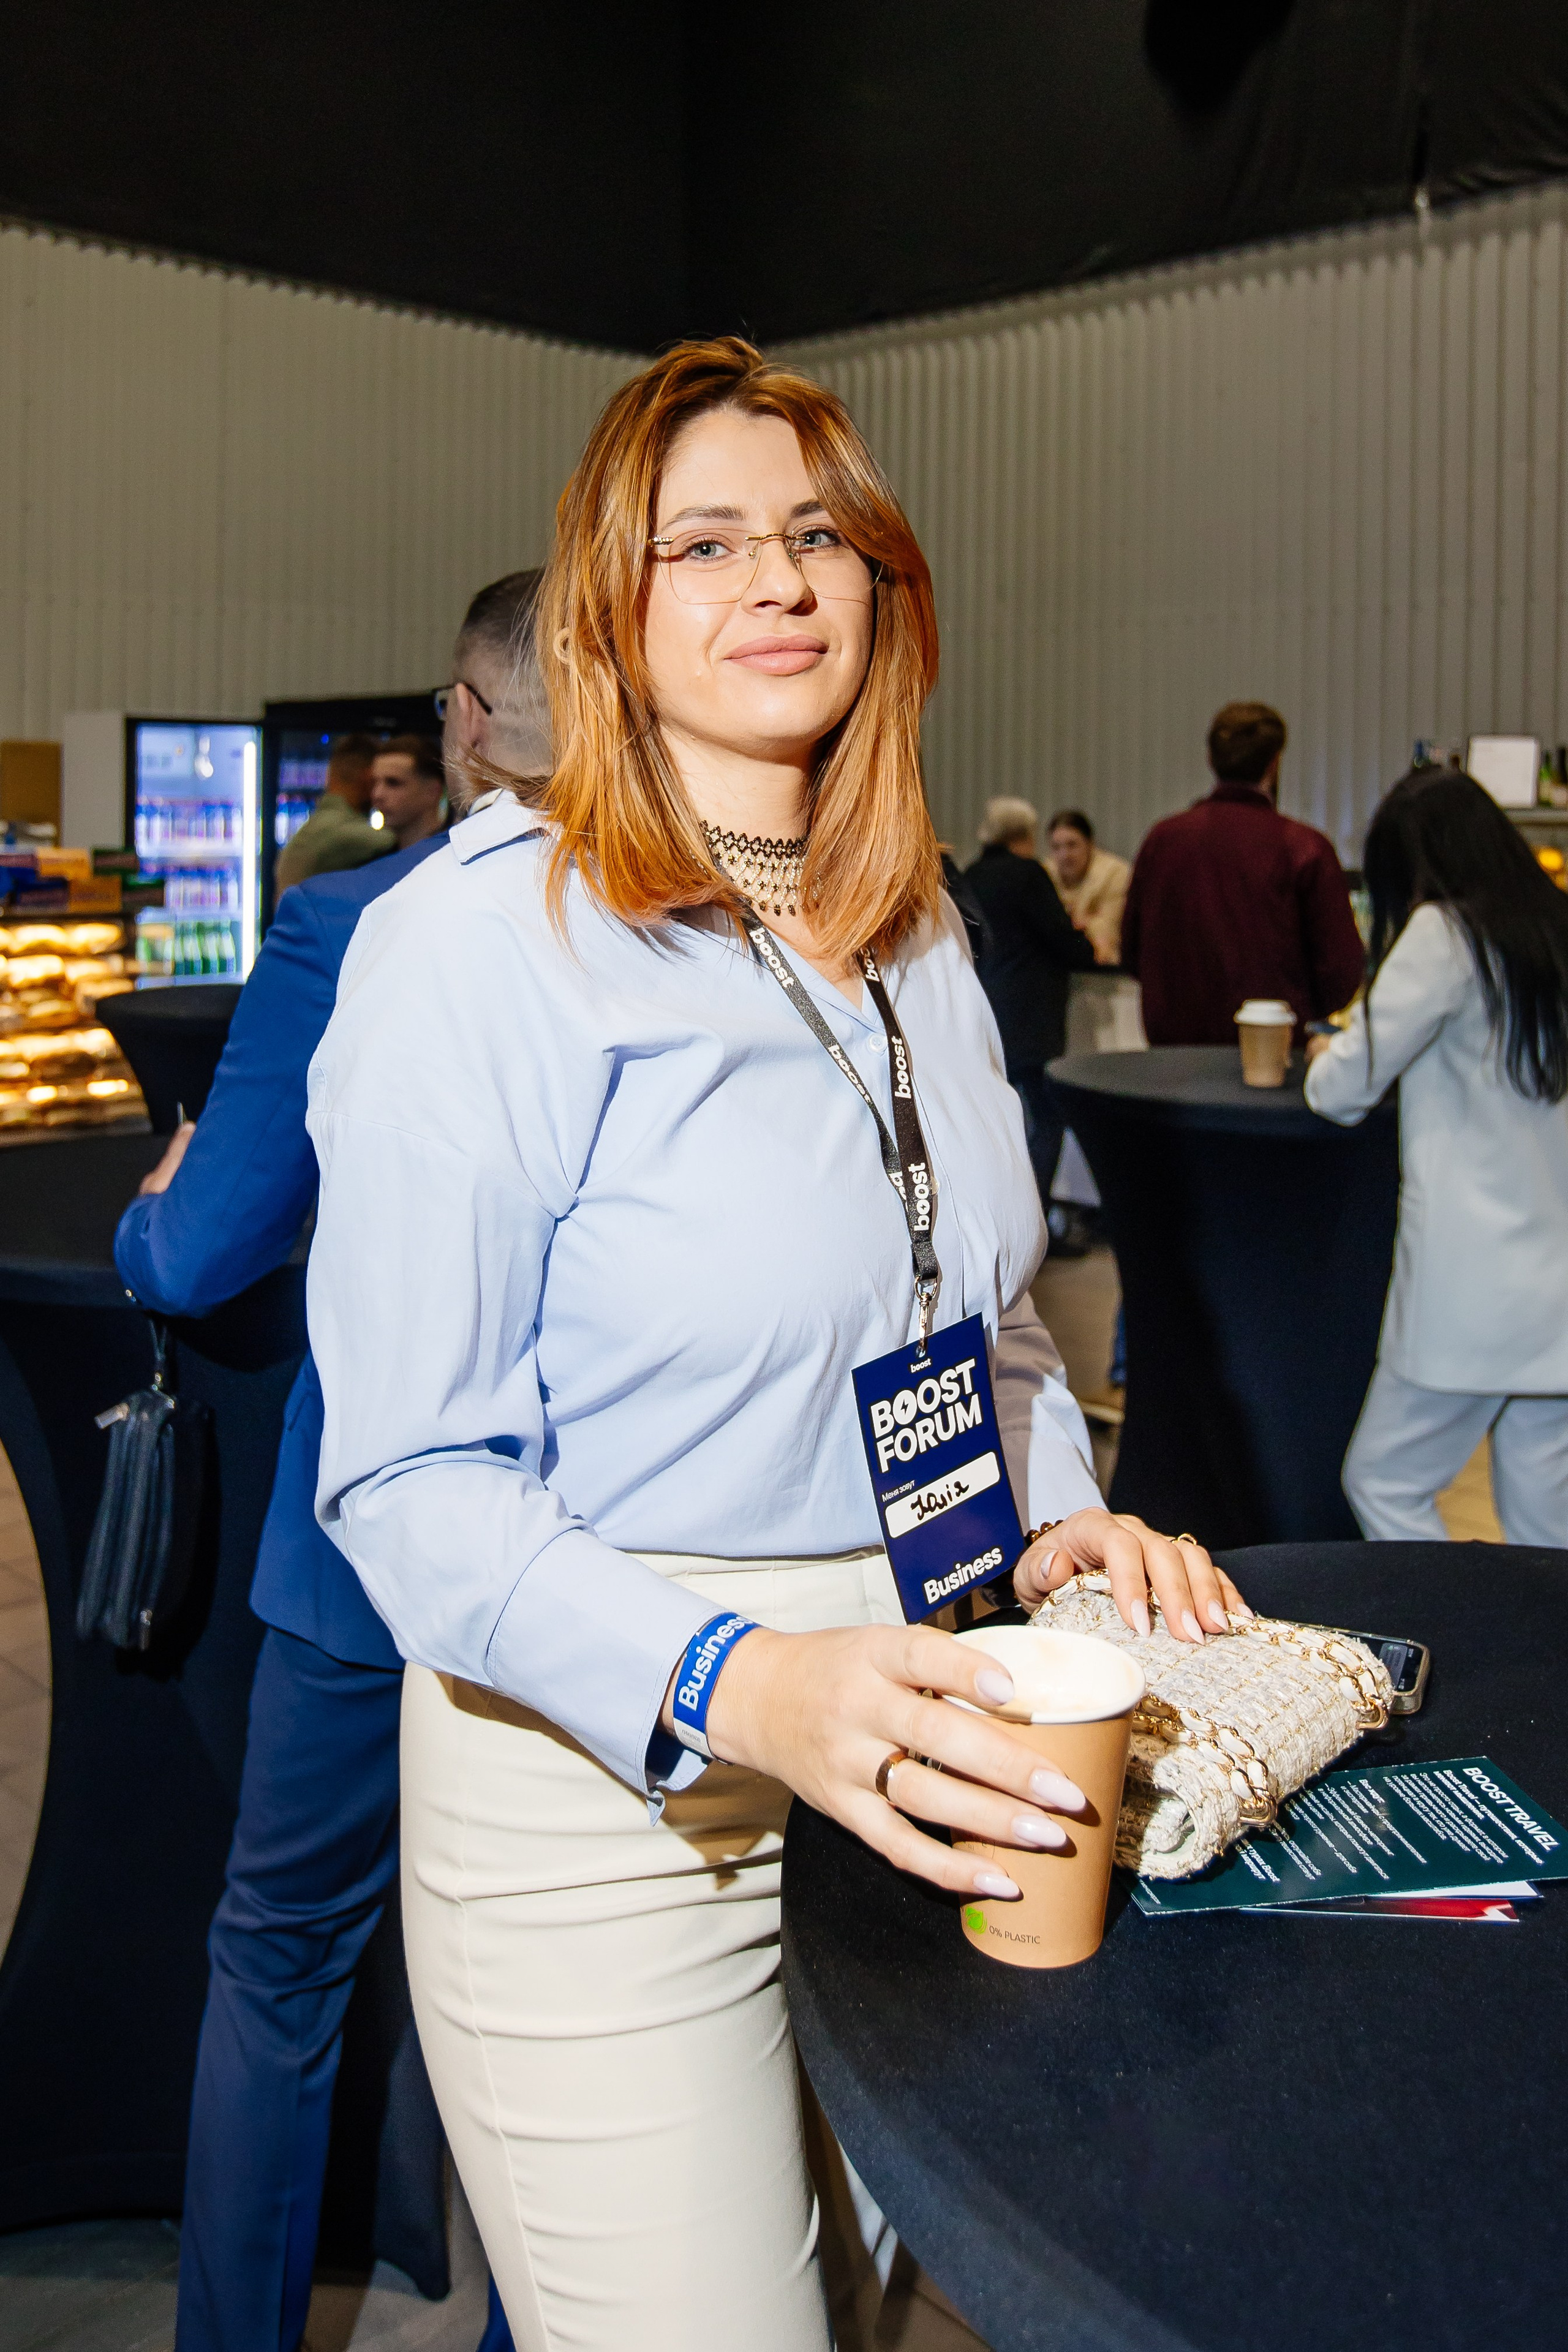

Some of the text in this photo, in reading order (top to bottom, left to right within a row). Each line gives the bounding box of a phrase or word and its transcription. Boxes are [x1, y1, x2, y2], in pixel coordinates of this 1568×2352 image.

[749, 927, 794, 988] boost
[828, 1044, 871, 1102] boost
[891, 1035, 911, 1099] boost
[908, 1163, 930, 1231] boost
[910, 1357, 931, 1373] boost
[870, 1358, 976, 1439] BOOST
[876, 1393, 982, 1474] FORUM
[881, 1479, 915, 1502] Меня зовут
[924, 1547, 1003, 1605] Business
[678, 1615, 754, 1711] Business
[1359, 1779, 1371, 1789] Вас
[1386, 1782, 1405, 1797] уровне
[1433, 1771, 1456, 1790] меняют
[1463, 1768, 1558, 1850] BOOST TRAVEL
[1404, 1779, 1422, 1793] рамки
[1475, 1849, 1491, 1860] свой
[1419, 1772, 1430, 1781] Это
[1433, 1786, 1450, 1801] просто
[1485, 1838, 1508, 1858] котором
[1443, 1770, 1461, 1784] Boost
[1458, 1784, 1478, 1799] Travel
[1515, 1839, 1544, 1863] которые
[1241, 1854, 1265, 1879] маршрут
[1249, 1849, 1265, 1864] турах
[1261, 1864, 1280, 1881] Boost
[1289, 1840, 1321, 1875] окружайте себя
[1298, 1864, 1315, 1879] станут
[1343, 1861, 1357, 1872] себя
[989, 1926, 1041, 1944] 0% PLASTIC
